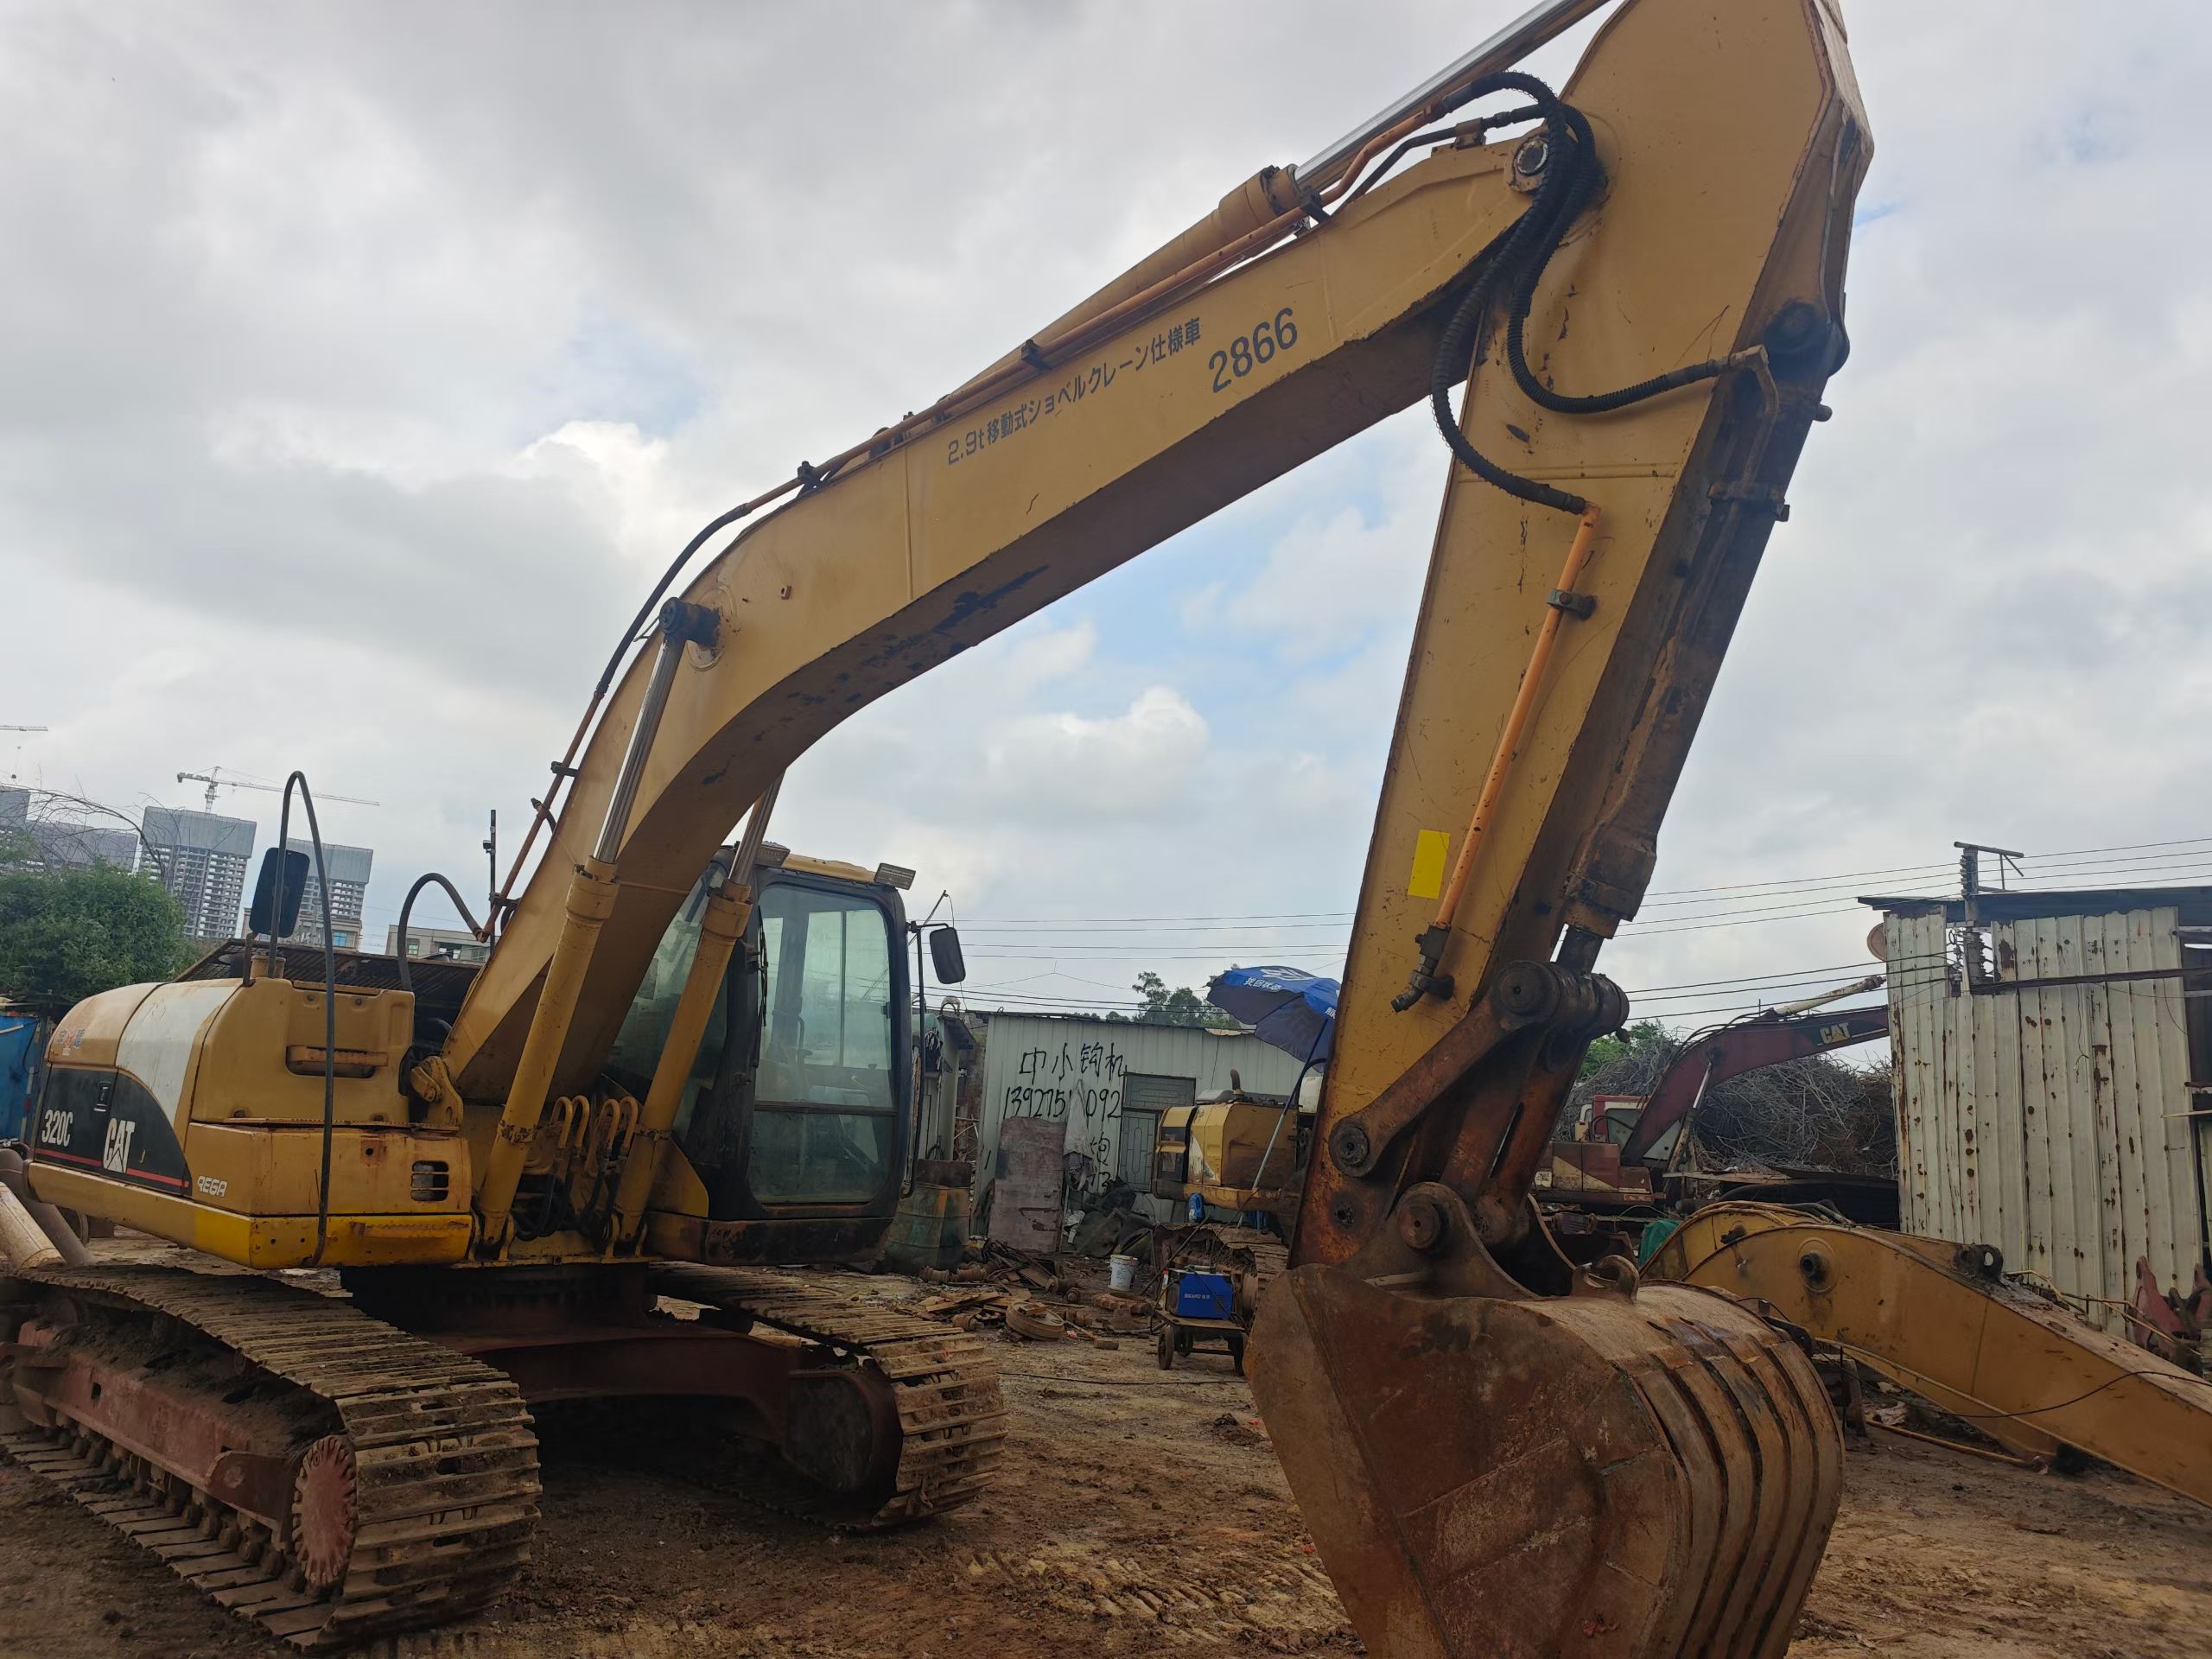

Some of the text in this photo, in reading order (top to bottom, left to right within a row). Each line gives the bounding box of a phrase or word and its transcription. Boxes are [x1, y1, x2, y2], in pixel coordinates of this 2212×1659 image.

[1209, 308, 1297, 393] 2866
[1820, 1022, 1850, 1044] CAT
[41, 1109, 73, 1147] 320C
[104, 1118, 136, 1173] CAT
